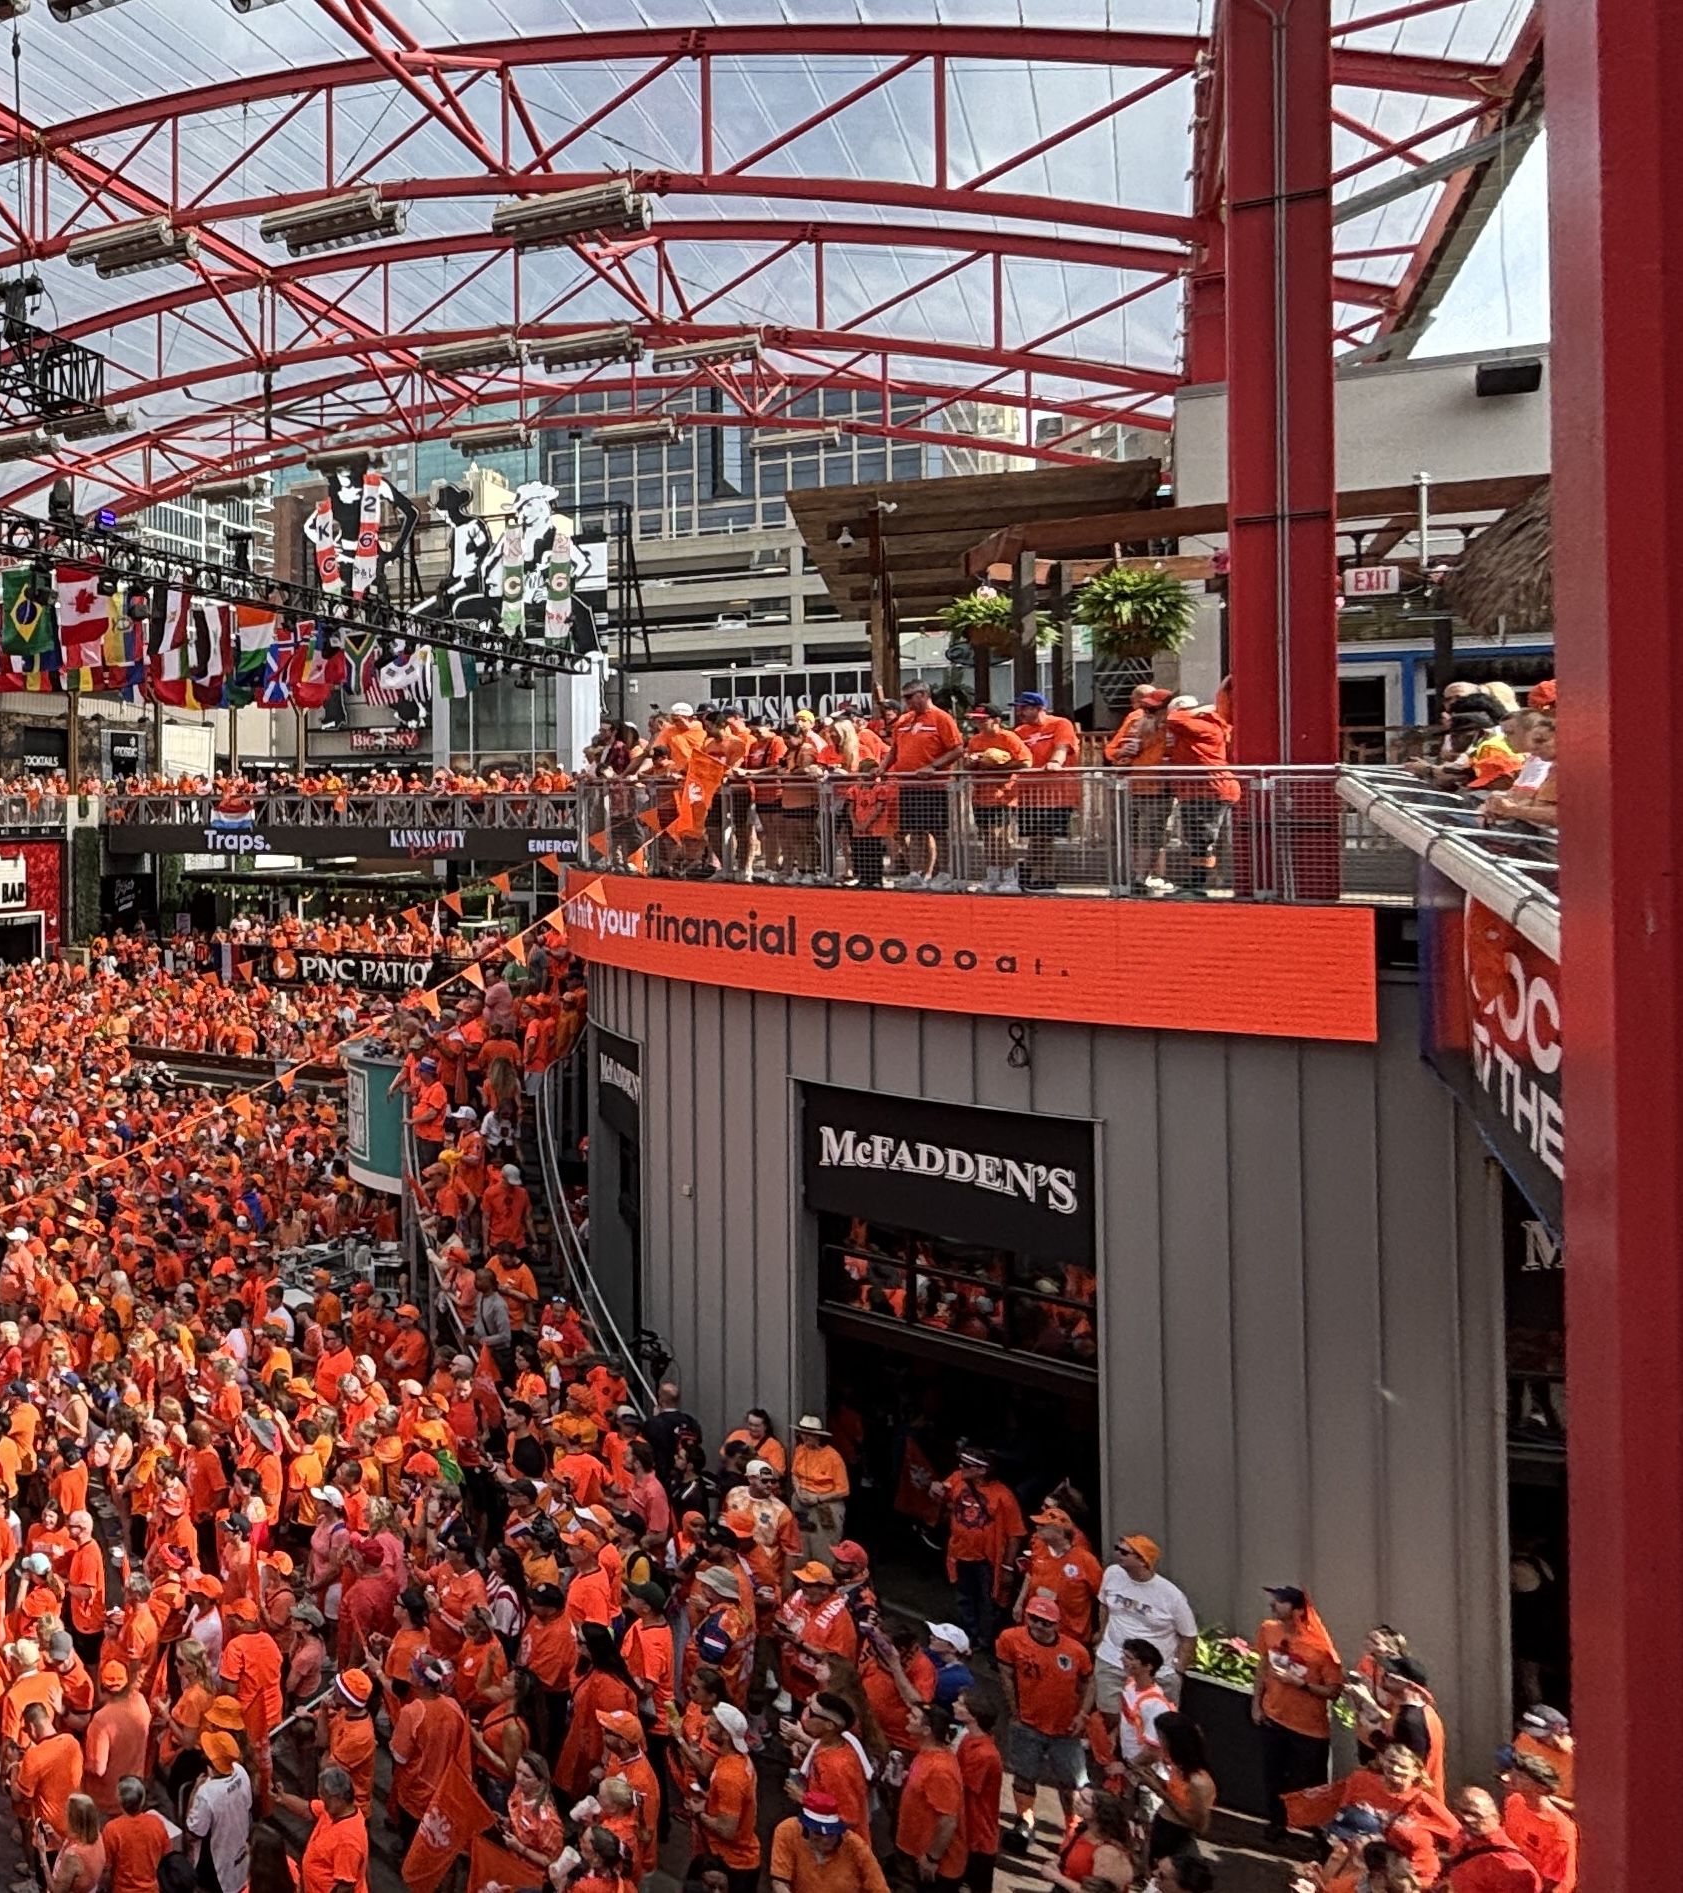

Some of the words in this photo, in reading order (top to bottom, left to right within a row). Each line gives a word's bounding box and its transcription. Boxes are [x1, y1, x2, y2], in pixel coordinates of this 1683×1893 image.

[364, 496, 376, 512] 2
[318, 522, 330, 541] K
[360, 533, 375, 547] 6
[504, 576, 521, 594] C
[552, 573, 568, 591] 6
[1354, 569, 1391, 592] EXIT
[353, 734, 375, 746] BIG
[387, 732, 416, 746] SKY
[204, 830, 271, 855] Traps.
[390, 830, 435, 848] KANSAS
[437, 830, 466, 848] CITY
[528, 839, 579, 853] ENERGY
[1, 882, 25, 903] BAR
[596, 907, 640, 940] your
[644, 903, 797, 956] financial
[299, 956, 355, 980] PNC
[360, 960, 429, 986] PATIO
[819, 1126, 1077, 1214] McFADDEN'S
